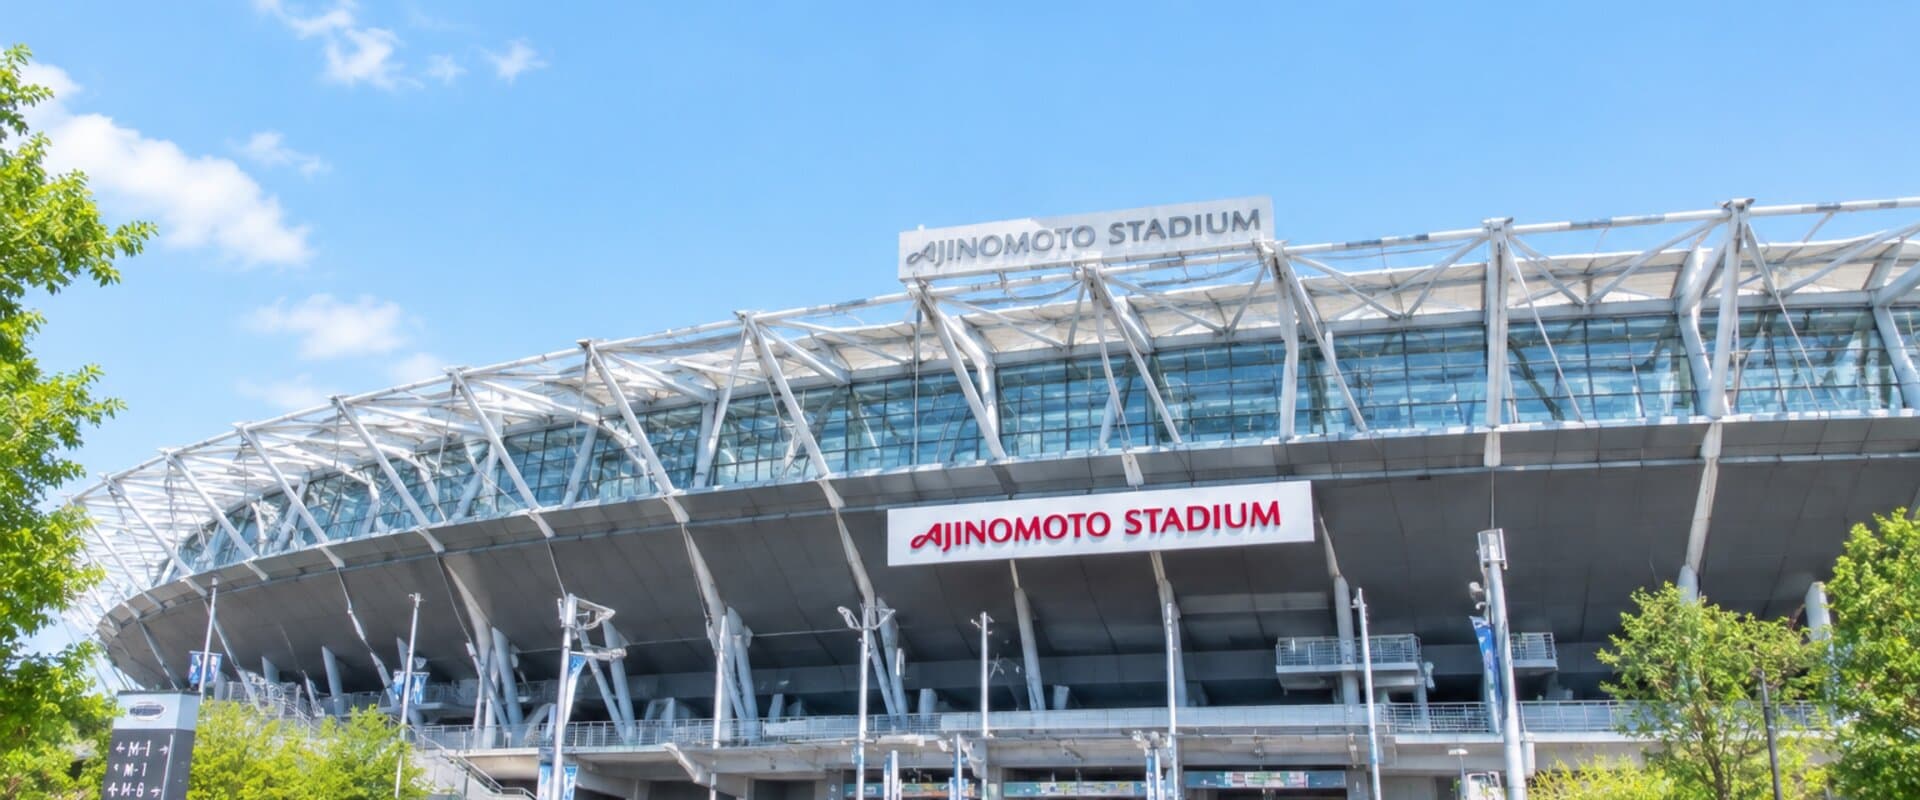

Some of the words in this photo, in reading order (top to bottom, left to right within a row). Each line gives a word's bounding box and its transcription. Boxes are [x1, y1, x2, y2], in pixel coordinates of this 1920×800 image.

[906, 225, 1096, 266] AJINOMOTO
[1109, 208, 1261, 245] STADIUM
[910, 511, 1111, 552] AJINOMOTO
[1125, 501, 1281, 535] STADIUM
